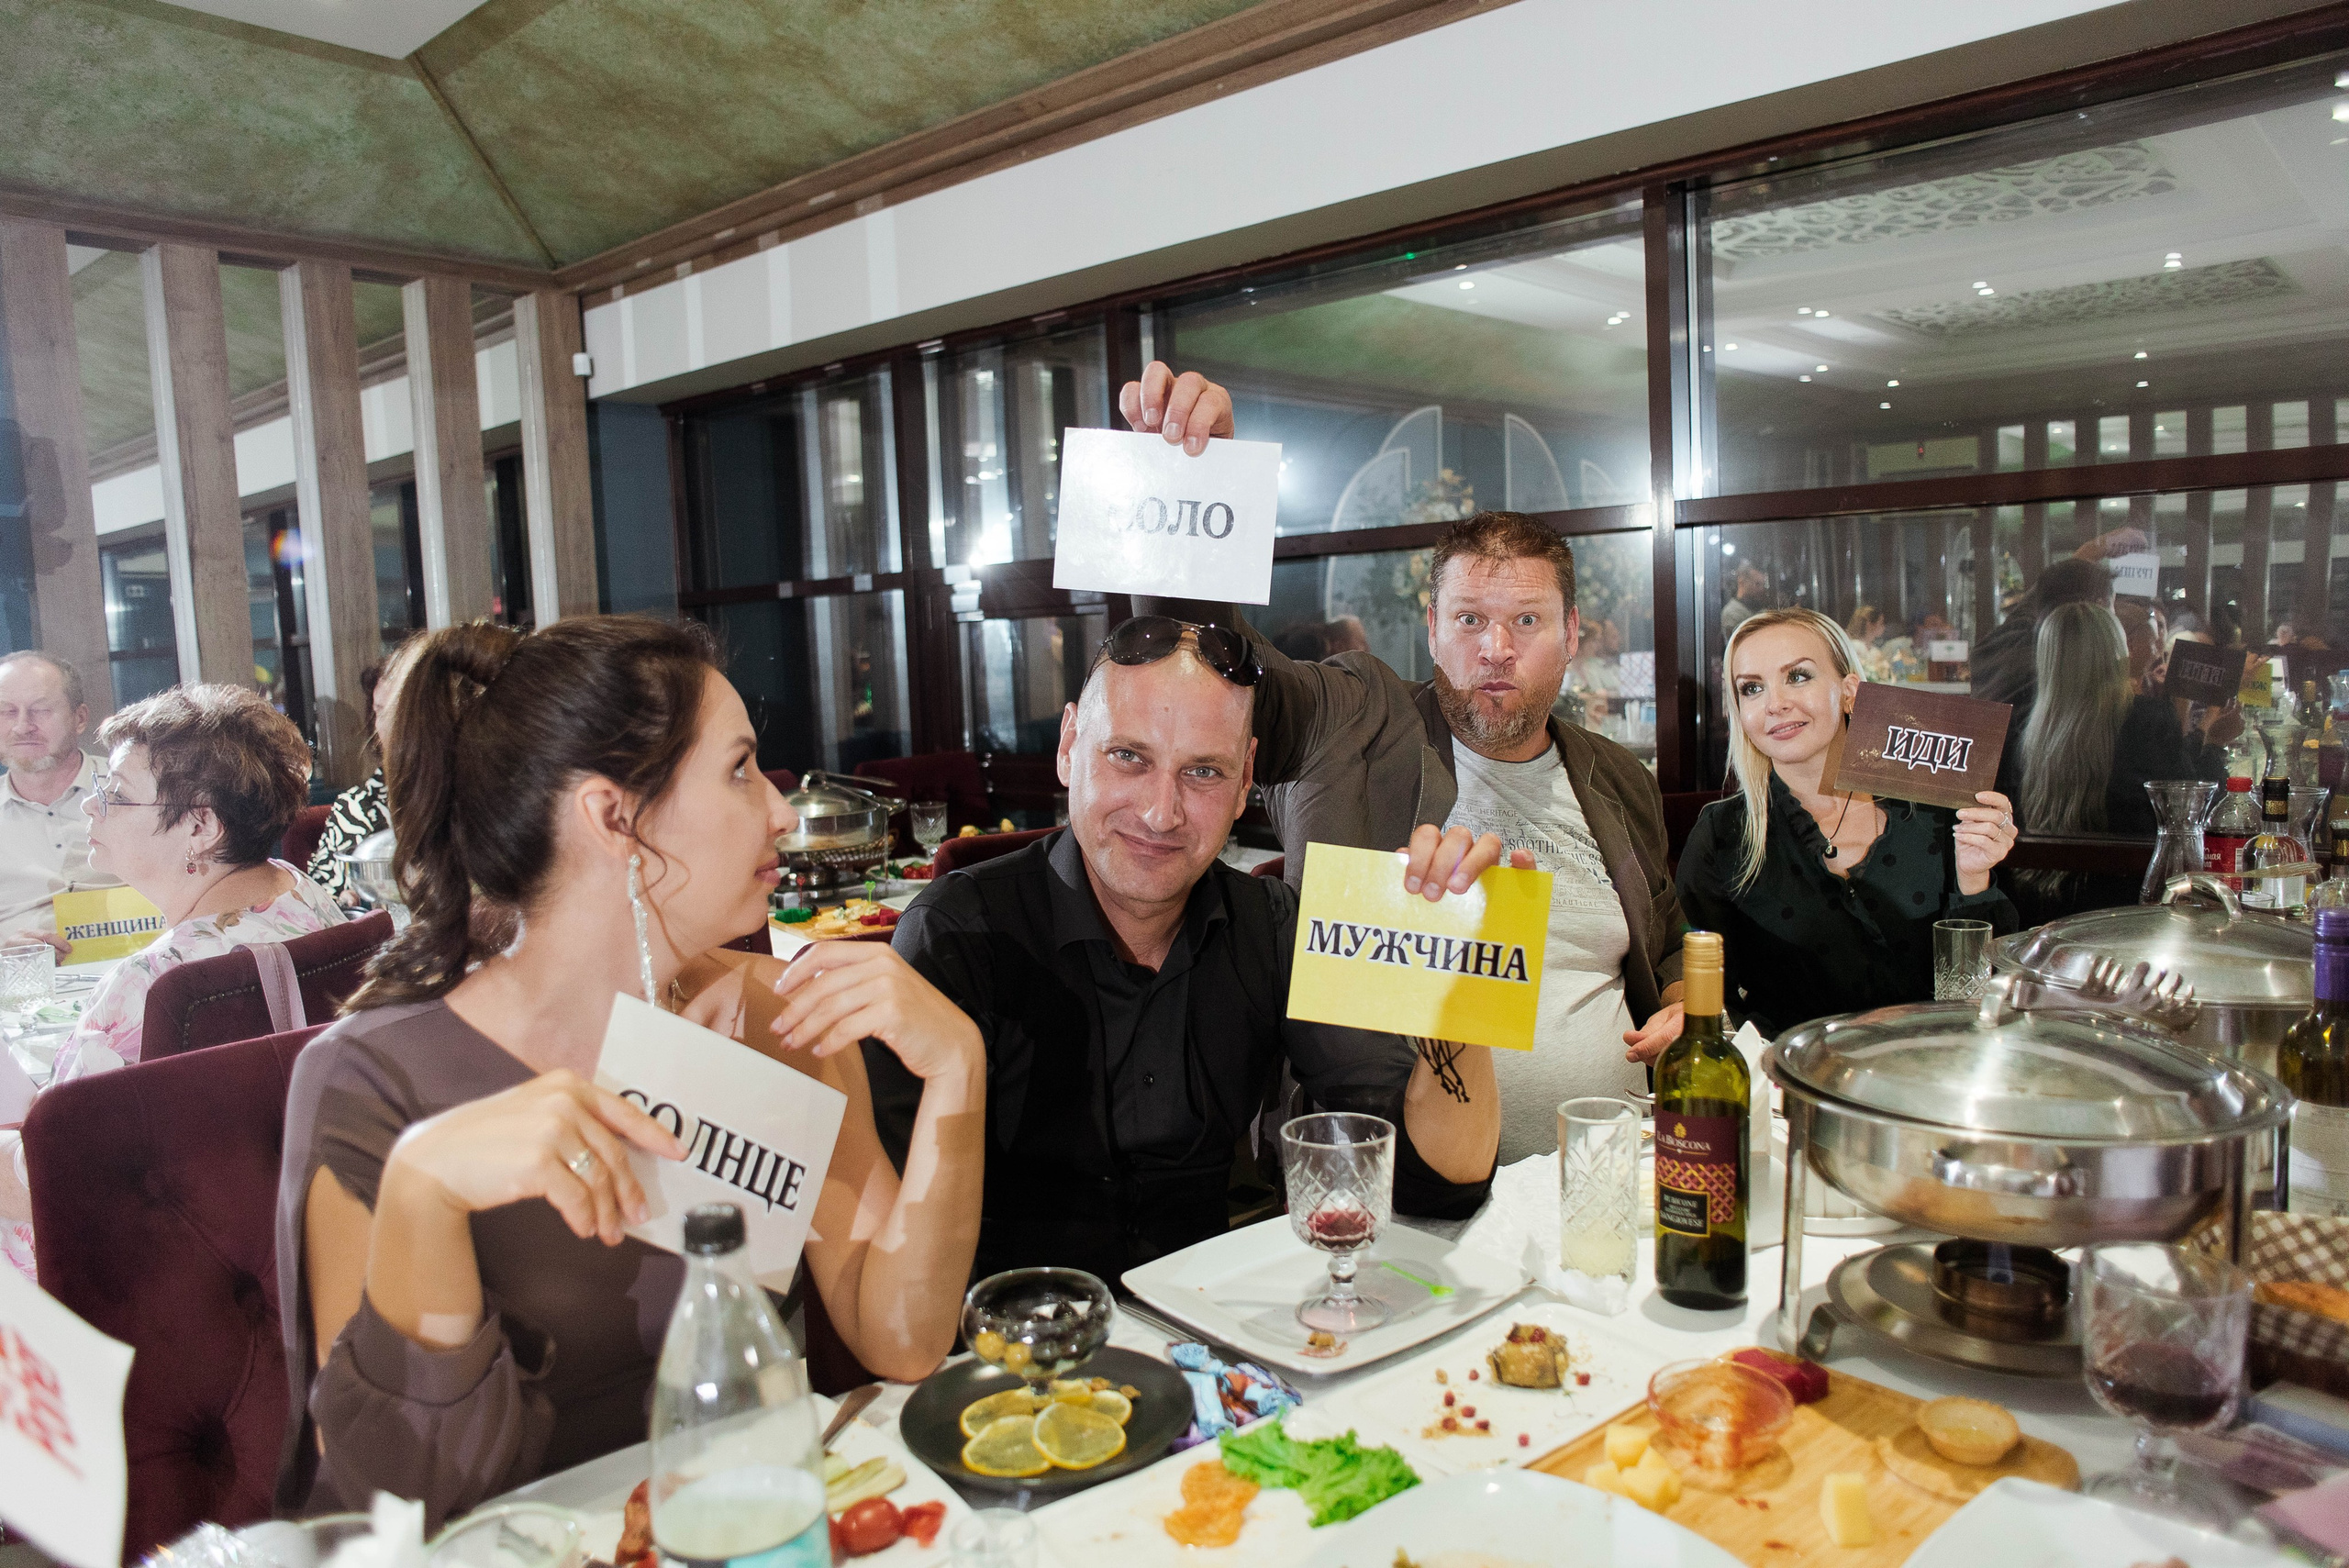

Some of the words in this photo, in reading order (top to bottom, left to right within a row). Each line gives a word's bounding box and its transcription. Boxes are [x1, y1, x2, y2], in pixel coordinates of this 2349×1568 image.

[1108, 496, 1235, 539] ОЛО
[1882, 726, 1974, 773] ИДИ
[1455, 803, 1474, 813] ICAL
[1479, 807, 1519, 818] HERITAGE
[64, 916, 166, 940] ЖЕНЩИНА
[1307, 919, 1530, 982] МУЖЧИНА
